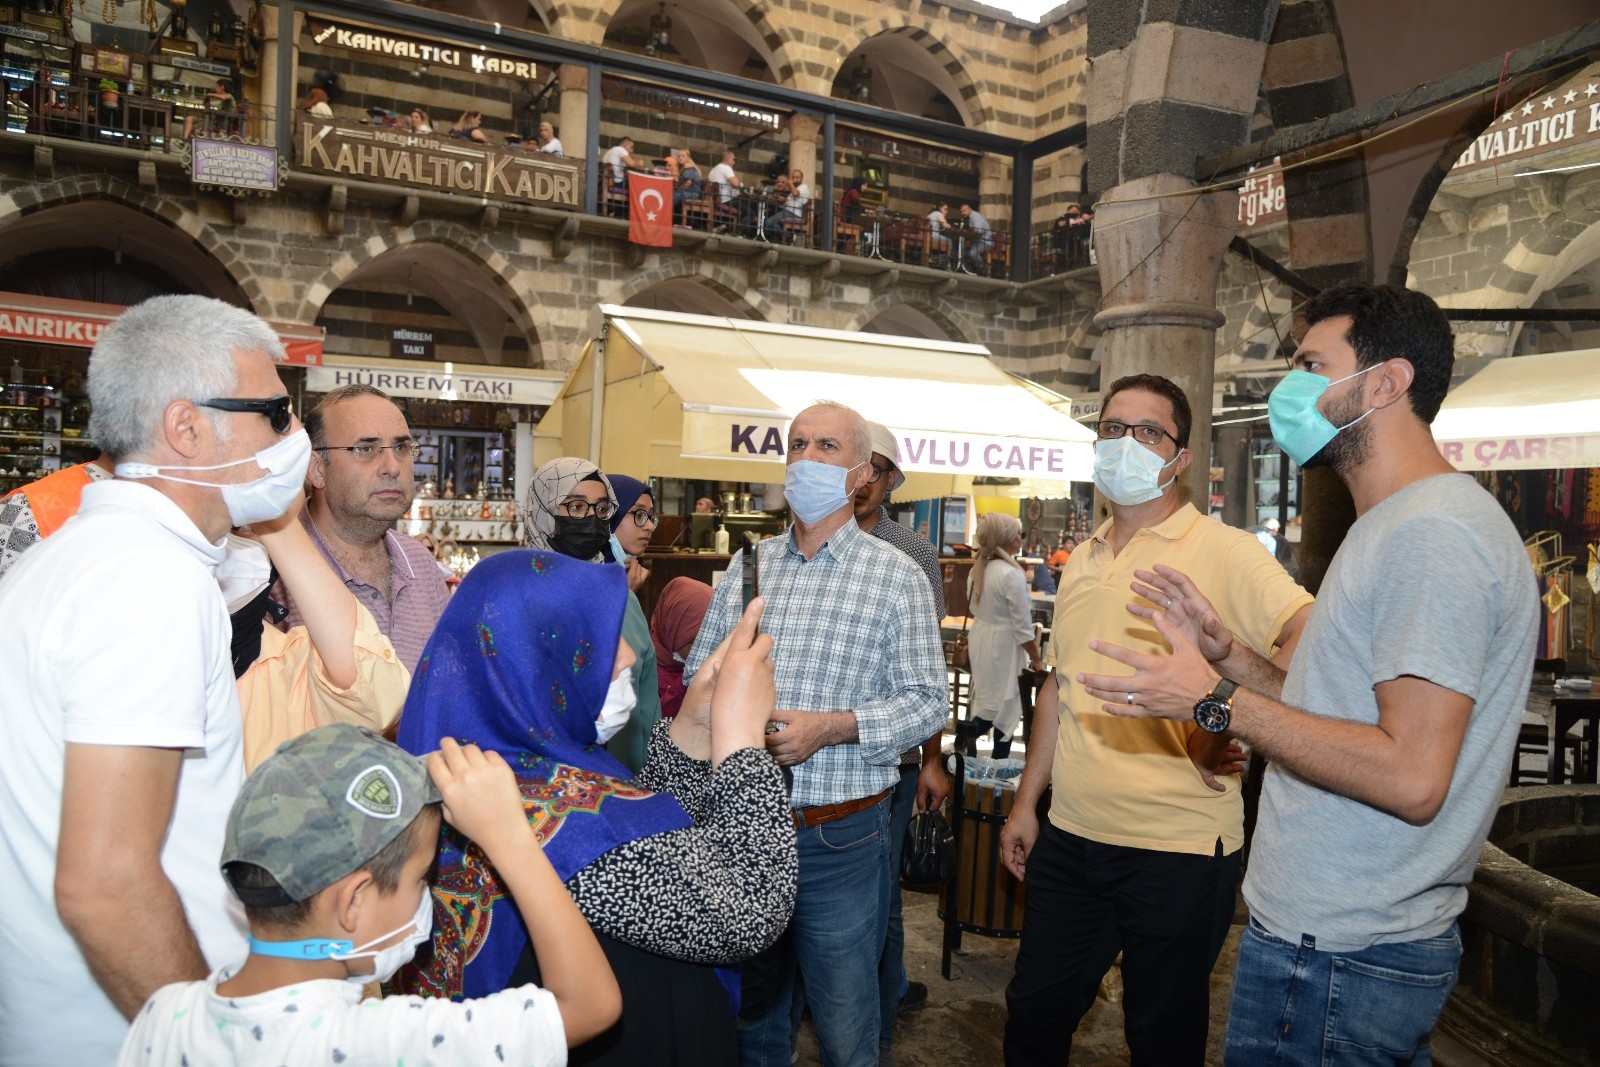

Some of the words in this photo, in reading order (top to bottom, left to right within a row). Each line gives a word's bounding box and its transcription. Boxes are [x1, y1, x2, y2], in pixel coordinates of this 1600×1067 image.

[337, 29, 460, 66] KAHVALTICI
[1452, 108, 1576, 169] HVALTICI
[301, 121, 482, 192] KAHVALTICI
[393, 328, 433, 342] HÜRREM
[402, 344, 425, 355] TAKI
[335, 368, 451, 391] HÜRREM
[460, 379, 513, 395] TAKI
[983, 443, 1064, 473] CAFE
